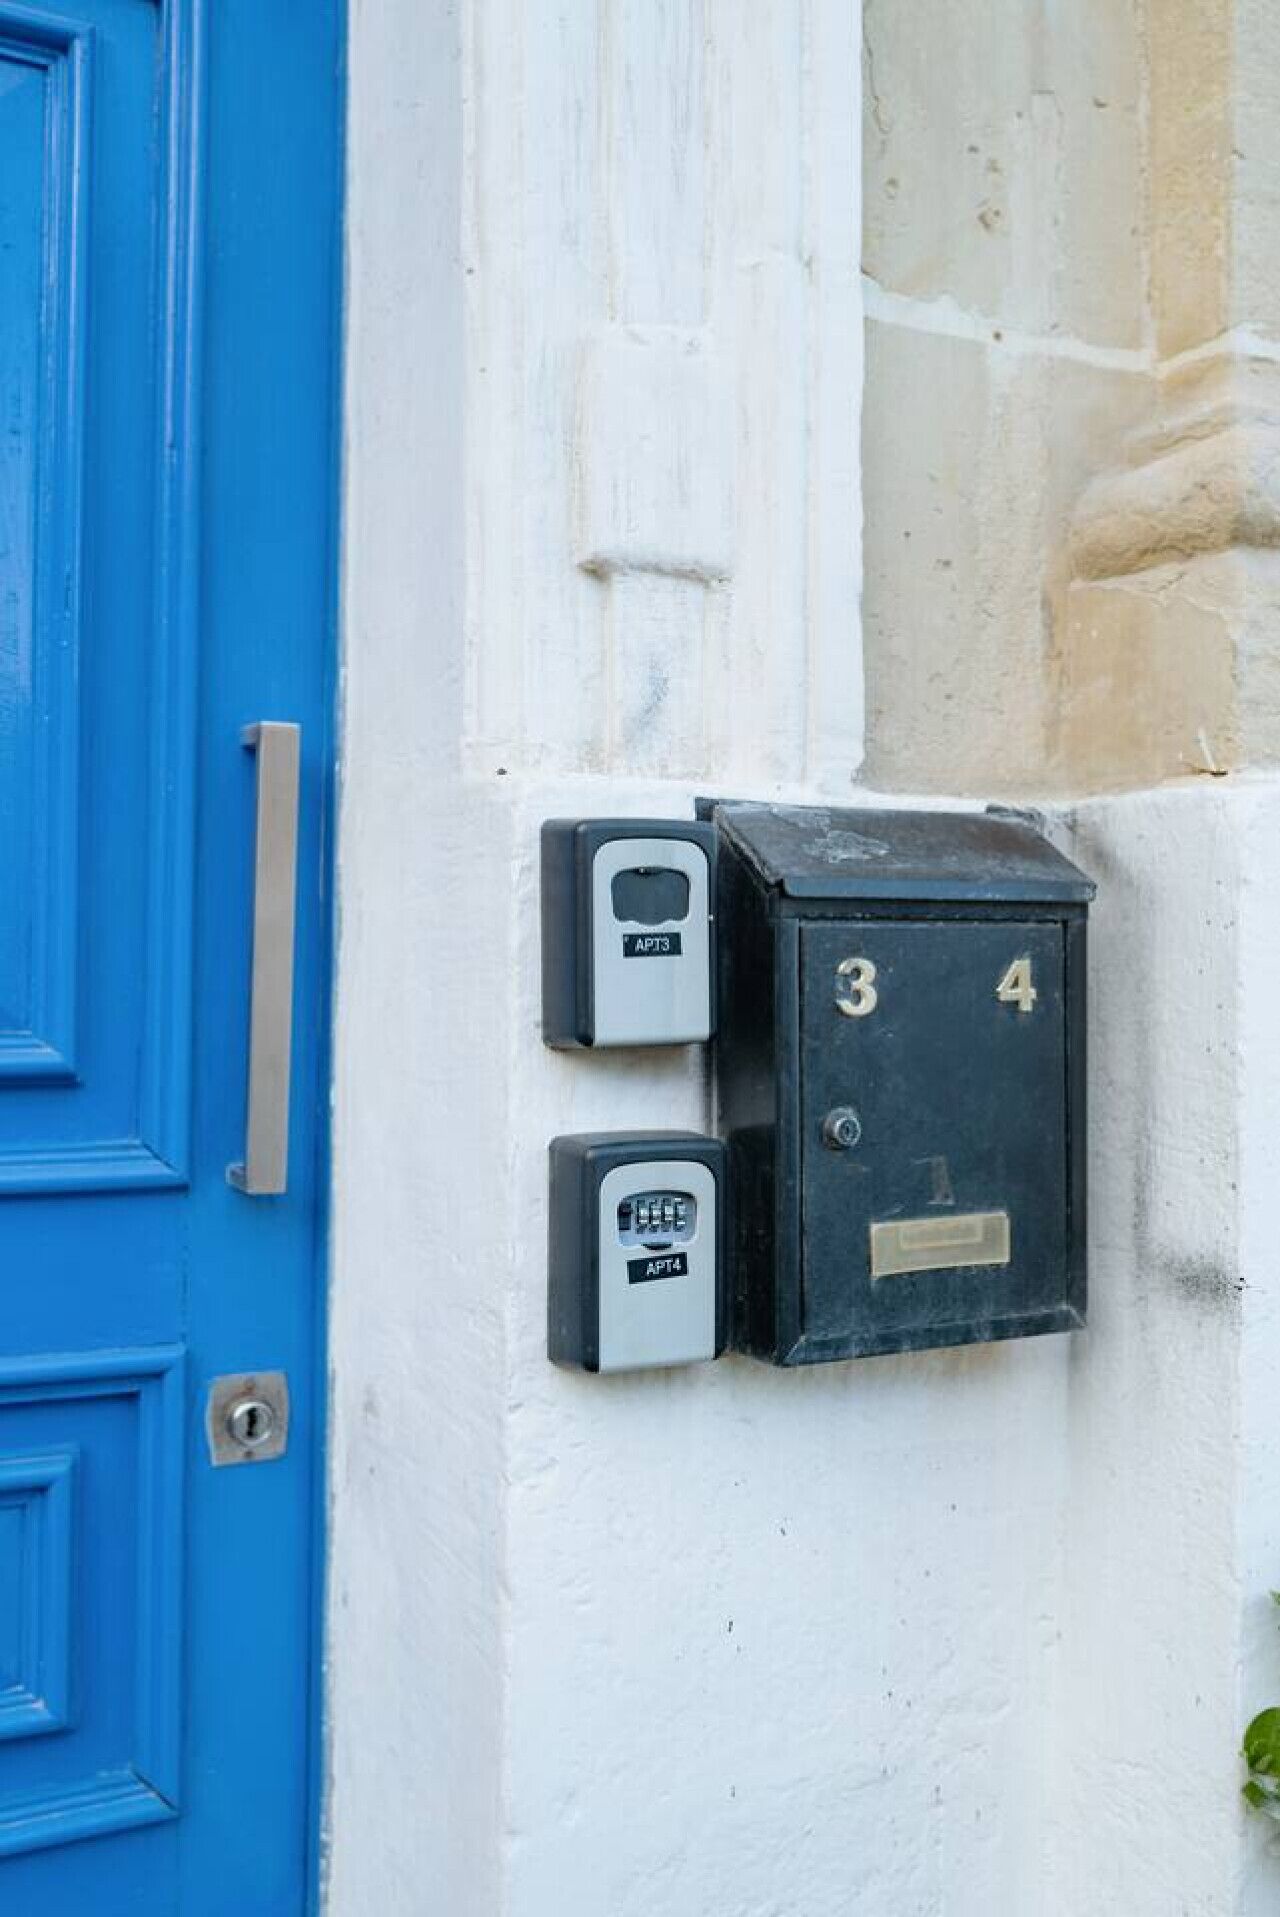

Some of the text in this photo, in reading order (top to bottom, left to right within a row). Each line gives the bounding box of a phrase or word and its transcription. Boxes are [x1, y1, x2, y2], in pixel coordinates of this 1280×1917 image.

[635, 937, 670, 951] APT3
[835, 957, 878, 1016] 3
[996, 958, 1037, 1012] 4
[646, 1257, 682, 1276] APT4
